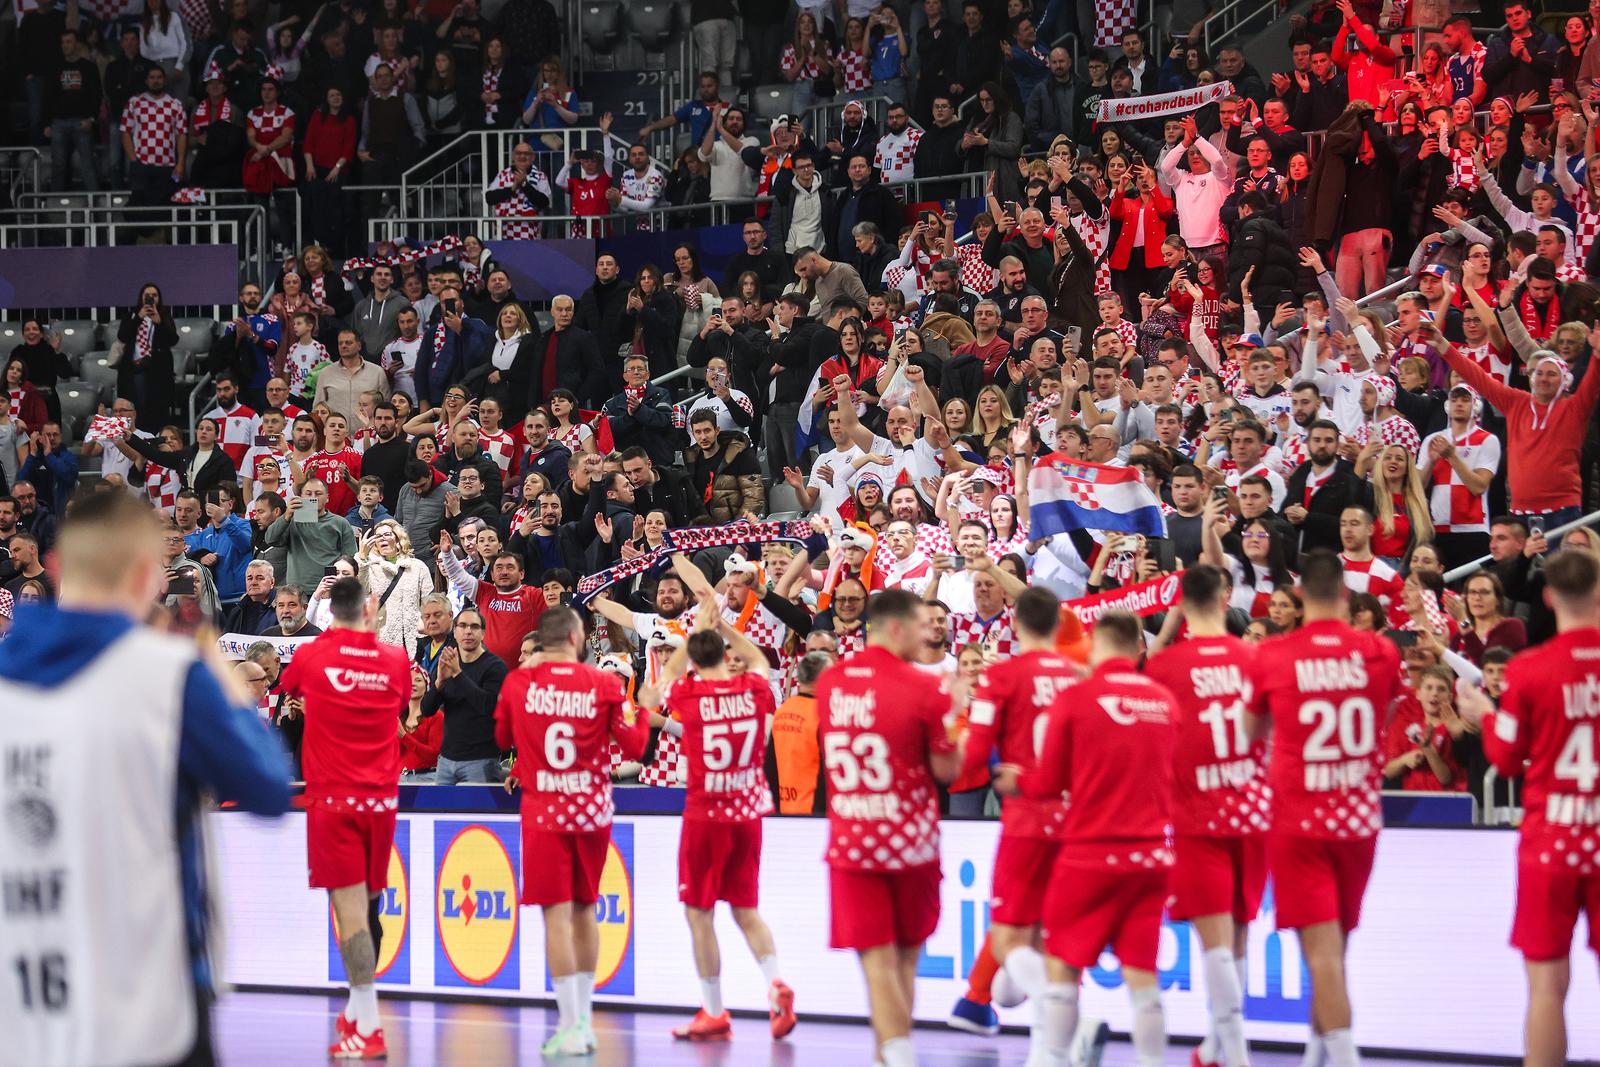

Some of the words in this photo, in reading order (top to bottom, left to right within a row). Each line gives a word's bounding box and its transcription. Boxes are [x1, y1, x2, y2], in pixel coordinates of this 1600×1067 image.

[881, 47, 889, 59] 7
[624, 101, 648, 115] 21
[1116, 92, 1204, 116] #crohandball
[326, 470, 340, 484] 88
[678, 526, 773, 546] HRVATSKA
[488, 598, 522, 613] HRATSKA
[1190, 665, 1242, 699] SRNA
[1294, 649, 1369, 693] MARAŠ
[525, 682, 597, 720] ŠOŠTARIĆ
[699, 688, 758, 722] GLAVAŠ
[544, 721, 577, 770] 6
[702, 719, 758, 771] 57
[1198, 699, 1249, 759] 11
[1298, 696, 1375, 762] 20
[824, 731, 893, 792] 53
[1554, 723, 1600, 793] 4
[595, 894, 625, 923] DL
[16, 950, 68, 1011] 16
